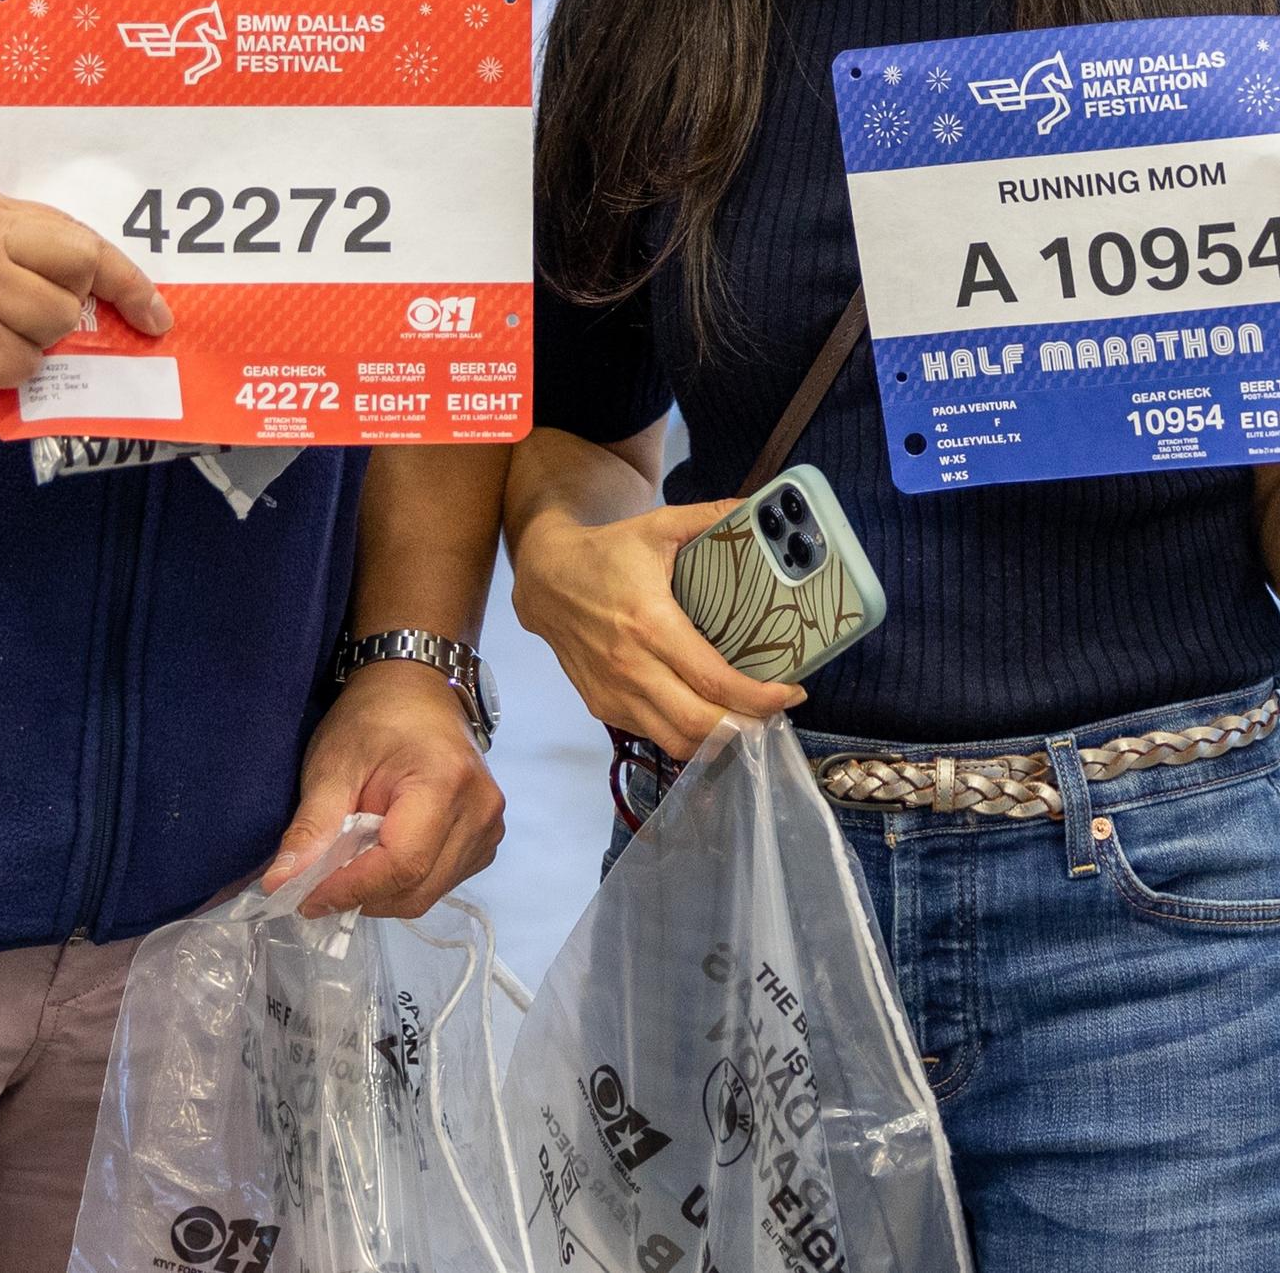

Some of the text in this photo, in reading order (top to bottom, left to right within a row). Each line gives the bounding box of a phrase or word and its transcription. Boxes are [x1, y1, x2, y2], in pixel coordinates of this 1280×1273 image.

[237, 15, 385, 32] BMW DALLAS
[237, 35, 365, 52] MARATHON
[236, 55, 343, 72] FESTIVAL
[1081, 51, 1226, 79] BMW DALLAS
[1083, 71, 1208, 99] MARATHON
[1085, 93, 1188, 119] FESTIVAL
[998, 162, 1227, 204] RUNNING MOM
[122, 186, 392, 254] 42272
[956, 242, 1018, 308] A
[922, 323, 1264, 382] HALF MARATHON
[243, 366, 327, 377] GEAR CHECK
[358, 362, 426, 375] BEER TAG
[450, 362, 517, 374] BEER TAG
[360, 375, 400, 383] POST-RACE
[452, 374, 516, 383] POST-RACE PARTY
[1240, 380, 1274, 393] BEER
[235, 382, 340, 410] 42272
[355, 393, 431, 412] EIGHT
[447, 393, 523, 411] EIGHT
[1132, 387, 1211, 404] GEAR CHECK
[1243, 392, 1280, 400] POST-RACE
[932, 400, 1017, 417] PAOLA VENTURA
[359, 414, 426, 422] ELITE LIGHT LAGER
[935, 418, 1001, 433] 42 F
[1127, 404, 1224, 436] 10954
[937, 433, 1021, 449] COLLEYVILLE, TX
[939, 454, 966, 465] W-XS
[941, 471, 968, 482] W-XS
[756, 961, 798, 1017] THE
[783, 1047, 809, 1076] IS
[587, 1102, 600, 1128] FORT
[598, 1129, 616, 1161] WORTH
[615, 1161, 641, 1194] DALLAS
[761, 1218, 793, 1255] ELITE
